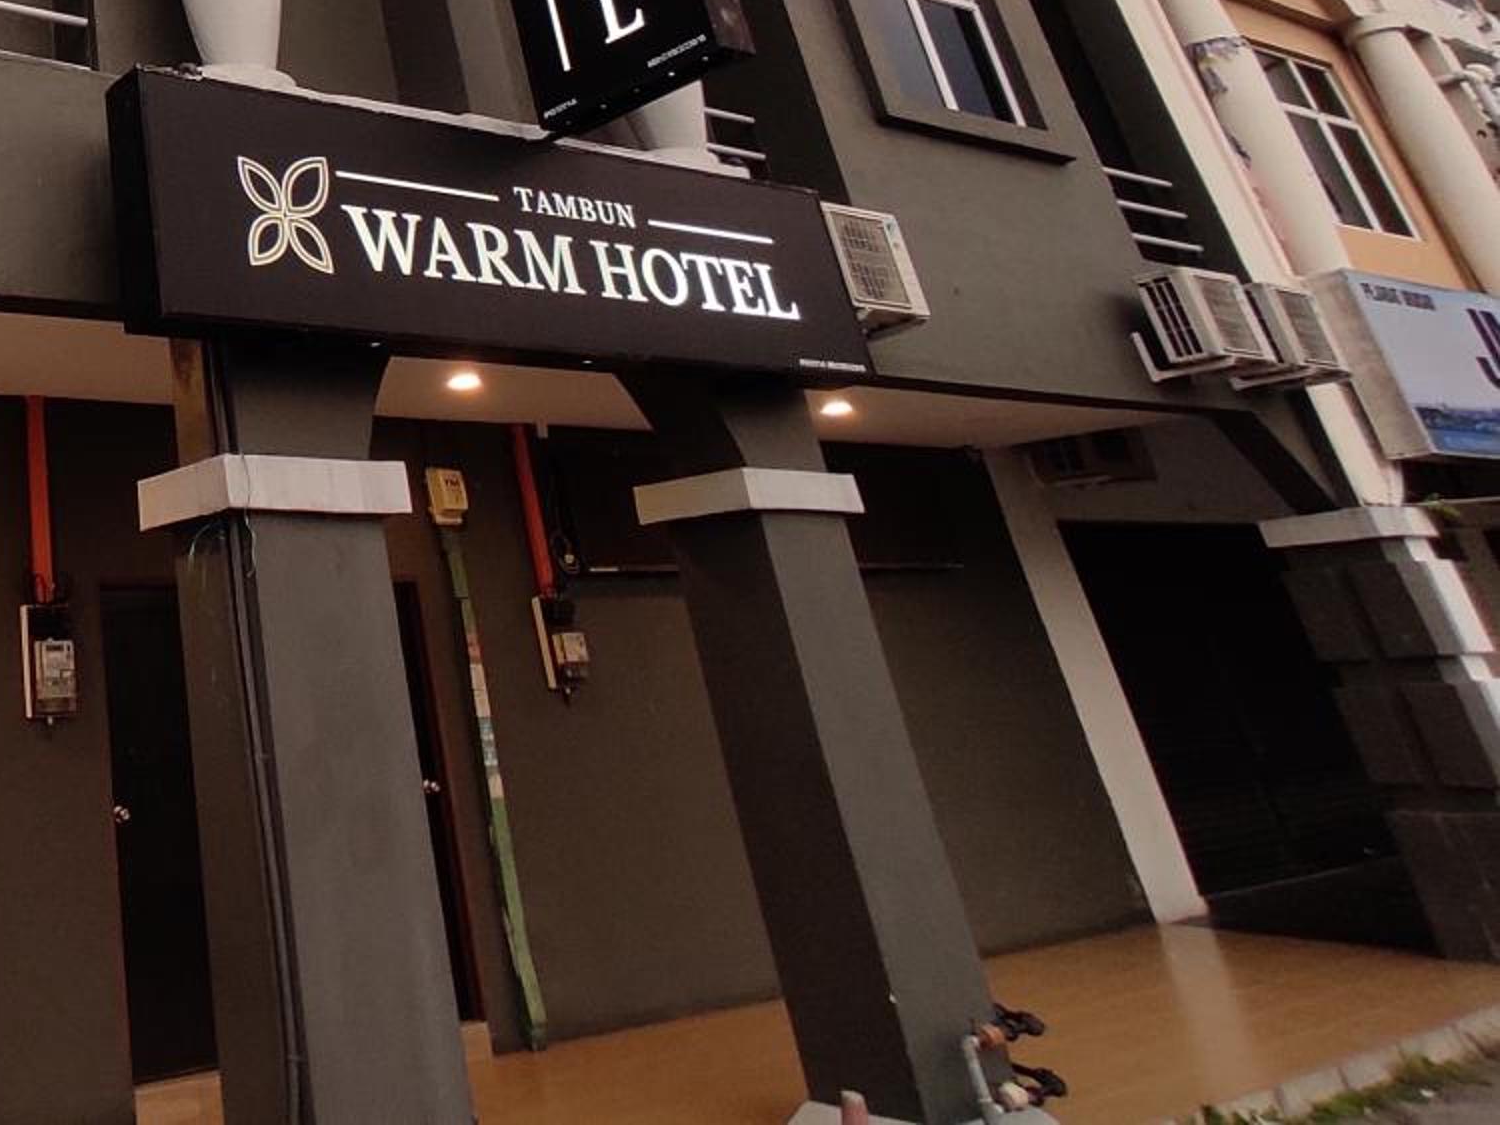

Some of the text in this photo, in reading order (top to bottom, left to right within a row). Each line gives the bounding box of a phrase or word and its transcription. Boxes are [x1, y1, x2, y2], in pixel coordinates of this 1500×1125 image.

[512, 186, 636, 229] TAMBUN
[340, 204, 801, 321] WARM HOTEL
